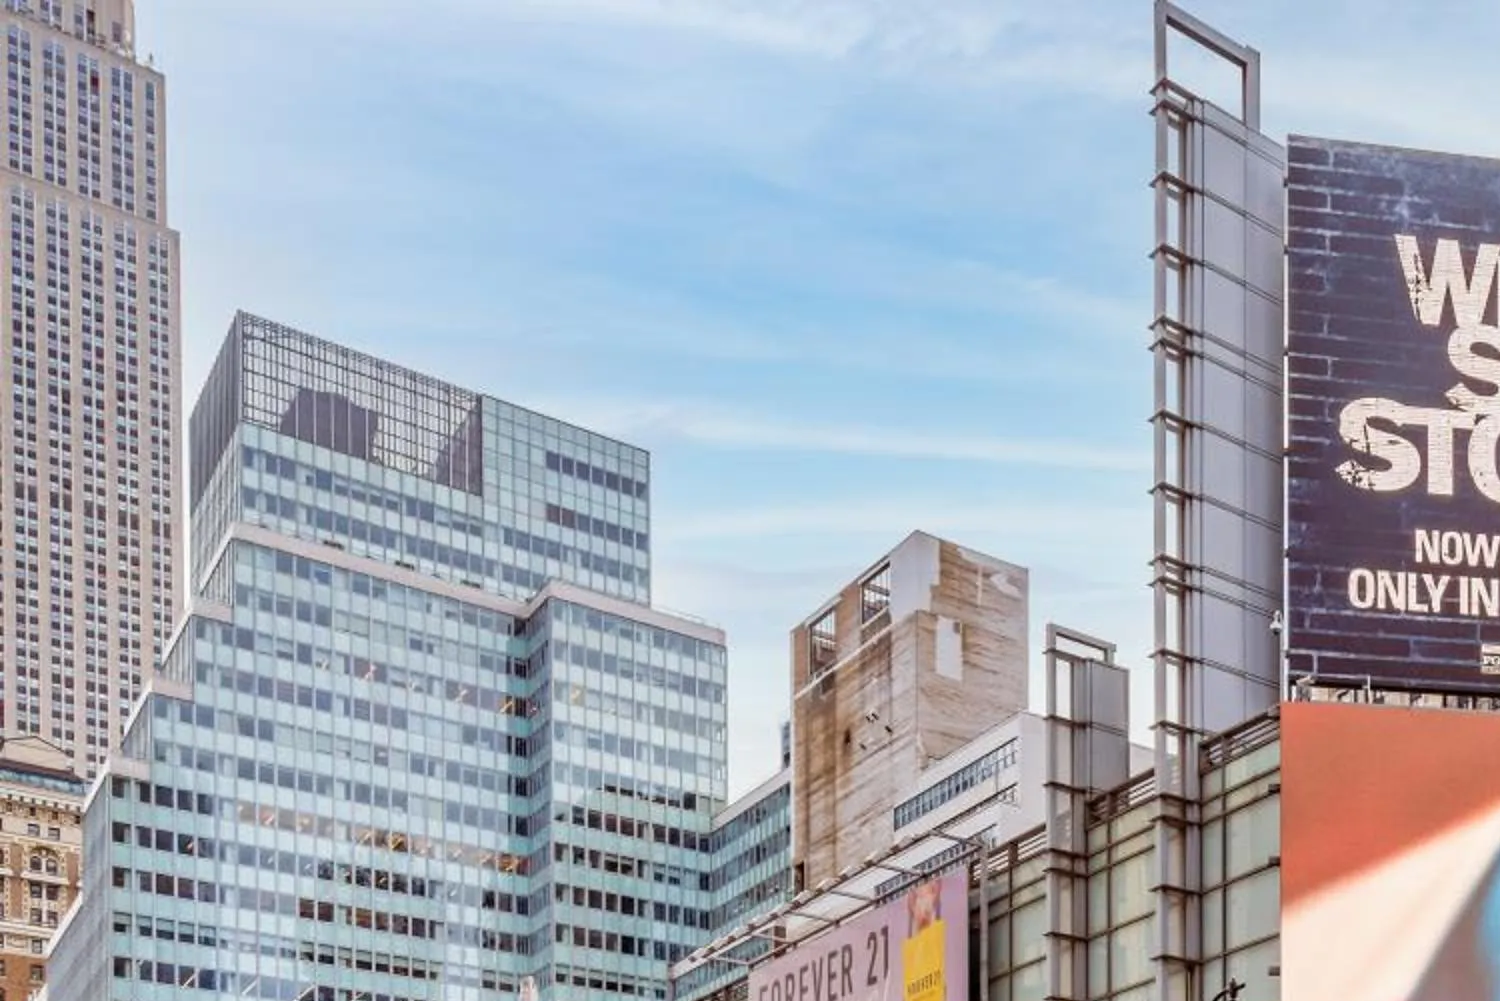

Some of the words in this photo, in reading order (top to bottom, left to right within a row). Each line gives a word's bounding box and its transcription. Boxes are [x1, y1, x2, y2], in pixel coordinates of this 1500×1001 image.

[1414, 529, 1500, 569] NOW
[1348, 568, 1450, 613] ONLY
[1459, 576, 1499, 617] IN
[866, 924, 889, 987] 21
